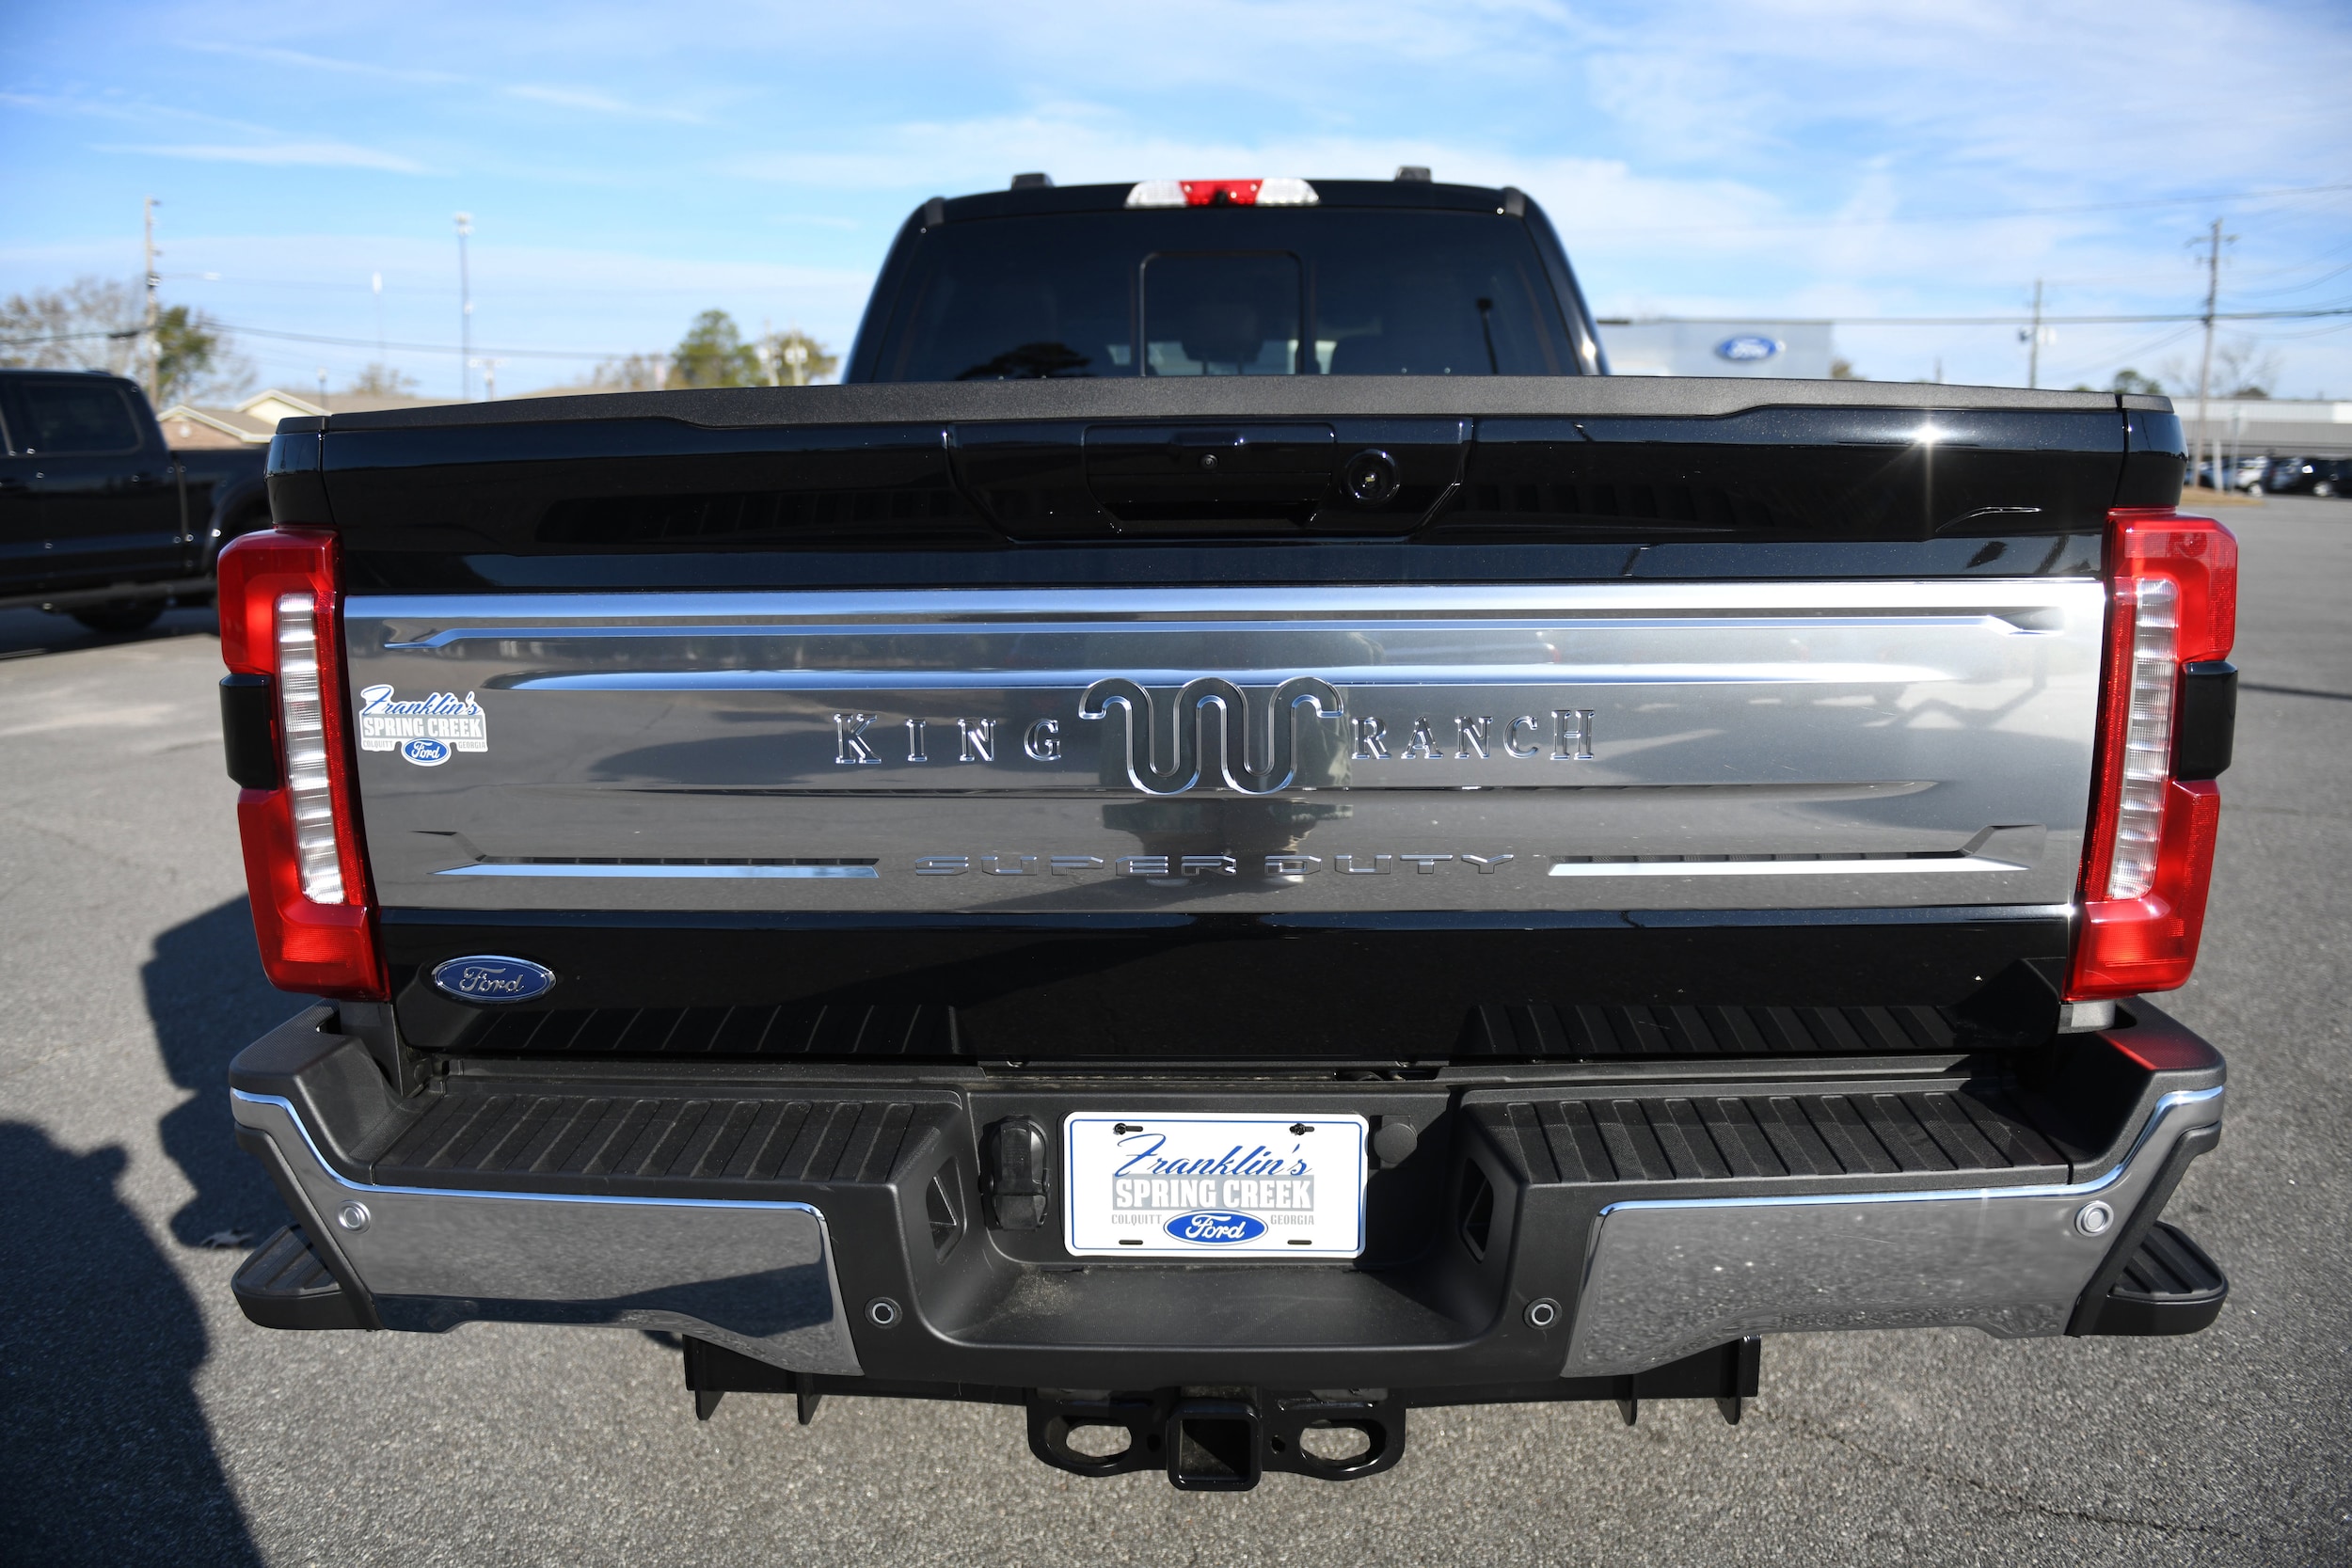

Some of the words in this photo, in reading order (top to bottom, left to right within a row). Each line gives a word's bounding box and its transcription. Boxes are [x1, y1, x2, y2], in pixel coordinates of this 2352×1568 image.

[362, 686, 481, 716] Franklin's
[363, 717, 423, 737] SPRING
[427, 718, 483, 737] CREEK
[834, 713, 1061, 765] KING
[1351, 709, 1596, 761] RANCH
[363, 739, 393, 748] COLQUITT
[411, 741, 440, 758] Ford
[915, 855, 1237, 876] SUPER
[1264, 854, 1515, 875] DUTY
[459, 966, 524, 992] Ford
[1114, 1133, 1312, 1177] Franklin's
[1116, 1179, 1216, 1208] SPRING
[1223, 1180, 1311, 1208] CREEK
[1111, 1214, 1162, 1225] COLQUITT
[1184, 1213, 1247, 1240] Ford
[1270, 1214, 1315, 1225] GEORGIA
